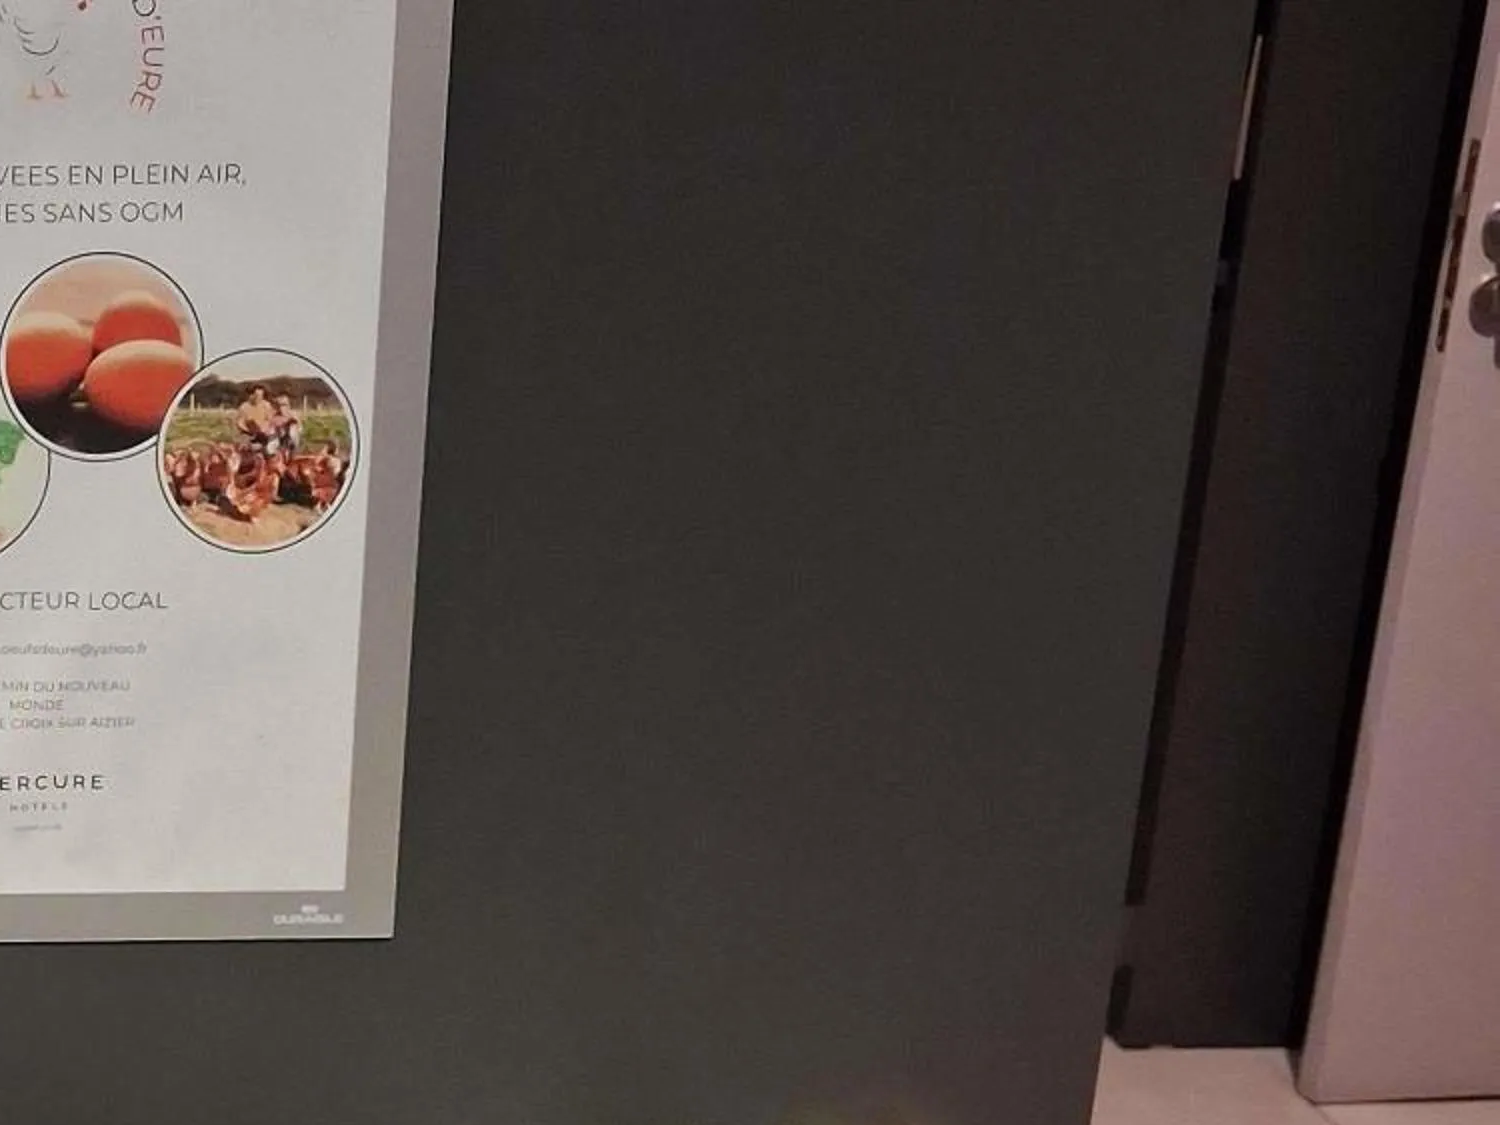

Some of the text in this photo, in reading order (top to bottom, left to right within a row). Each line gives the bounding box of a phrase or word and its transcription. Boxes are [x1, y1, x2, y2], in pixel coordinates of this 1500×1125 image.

[68, 165, 103, 186] EN
[112, 163, 189, 185] PLEIN
[43, 202, 113, 223] SANS
[120, 201, 184, 223] OGM
[88, 591, 169, 611] LOCAL
[33, 680, 55, 693] DU
[9, 699, 64, 711] MONDE
